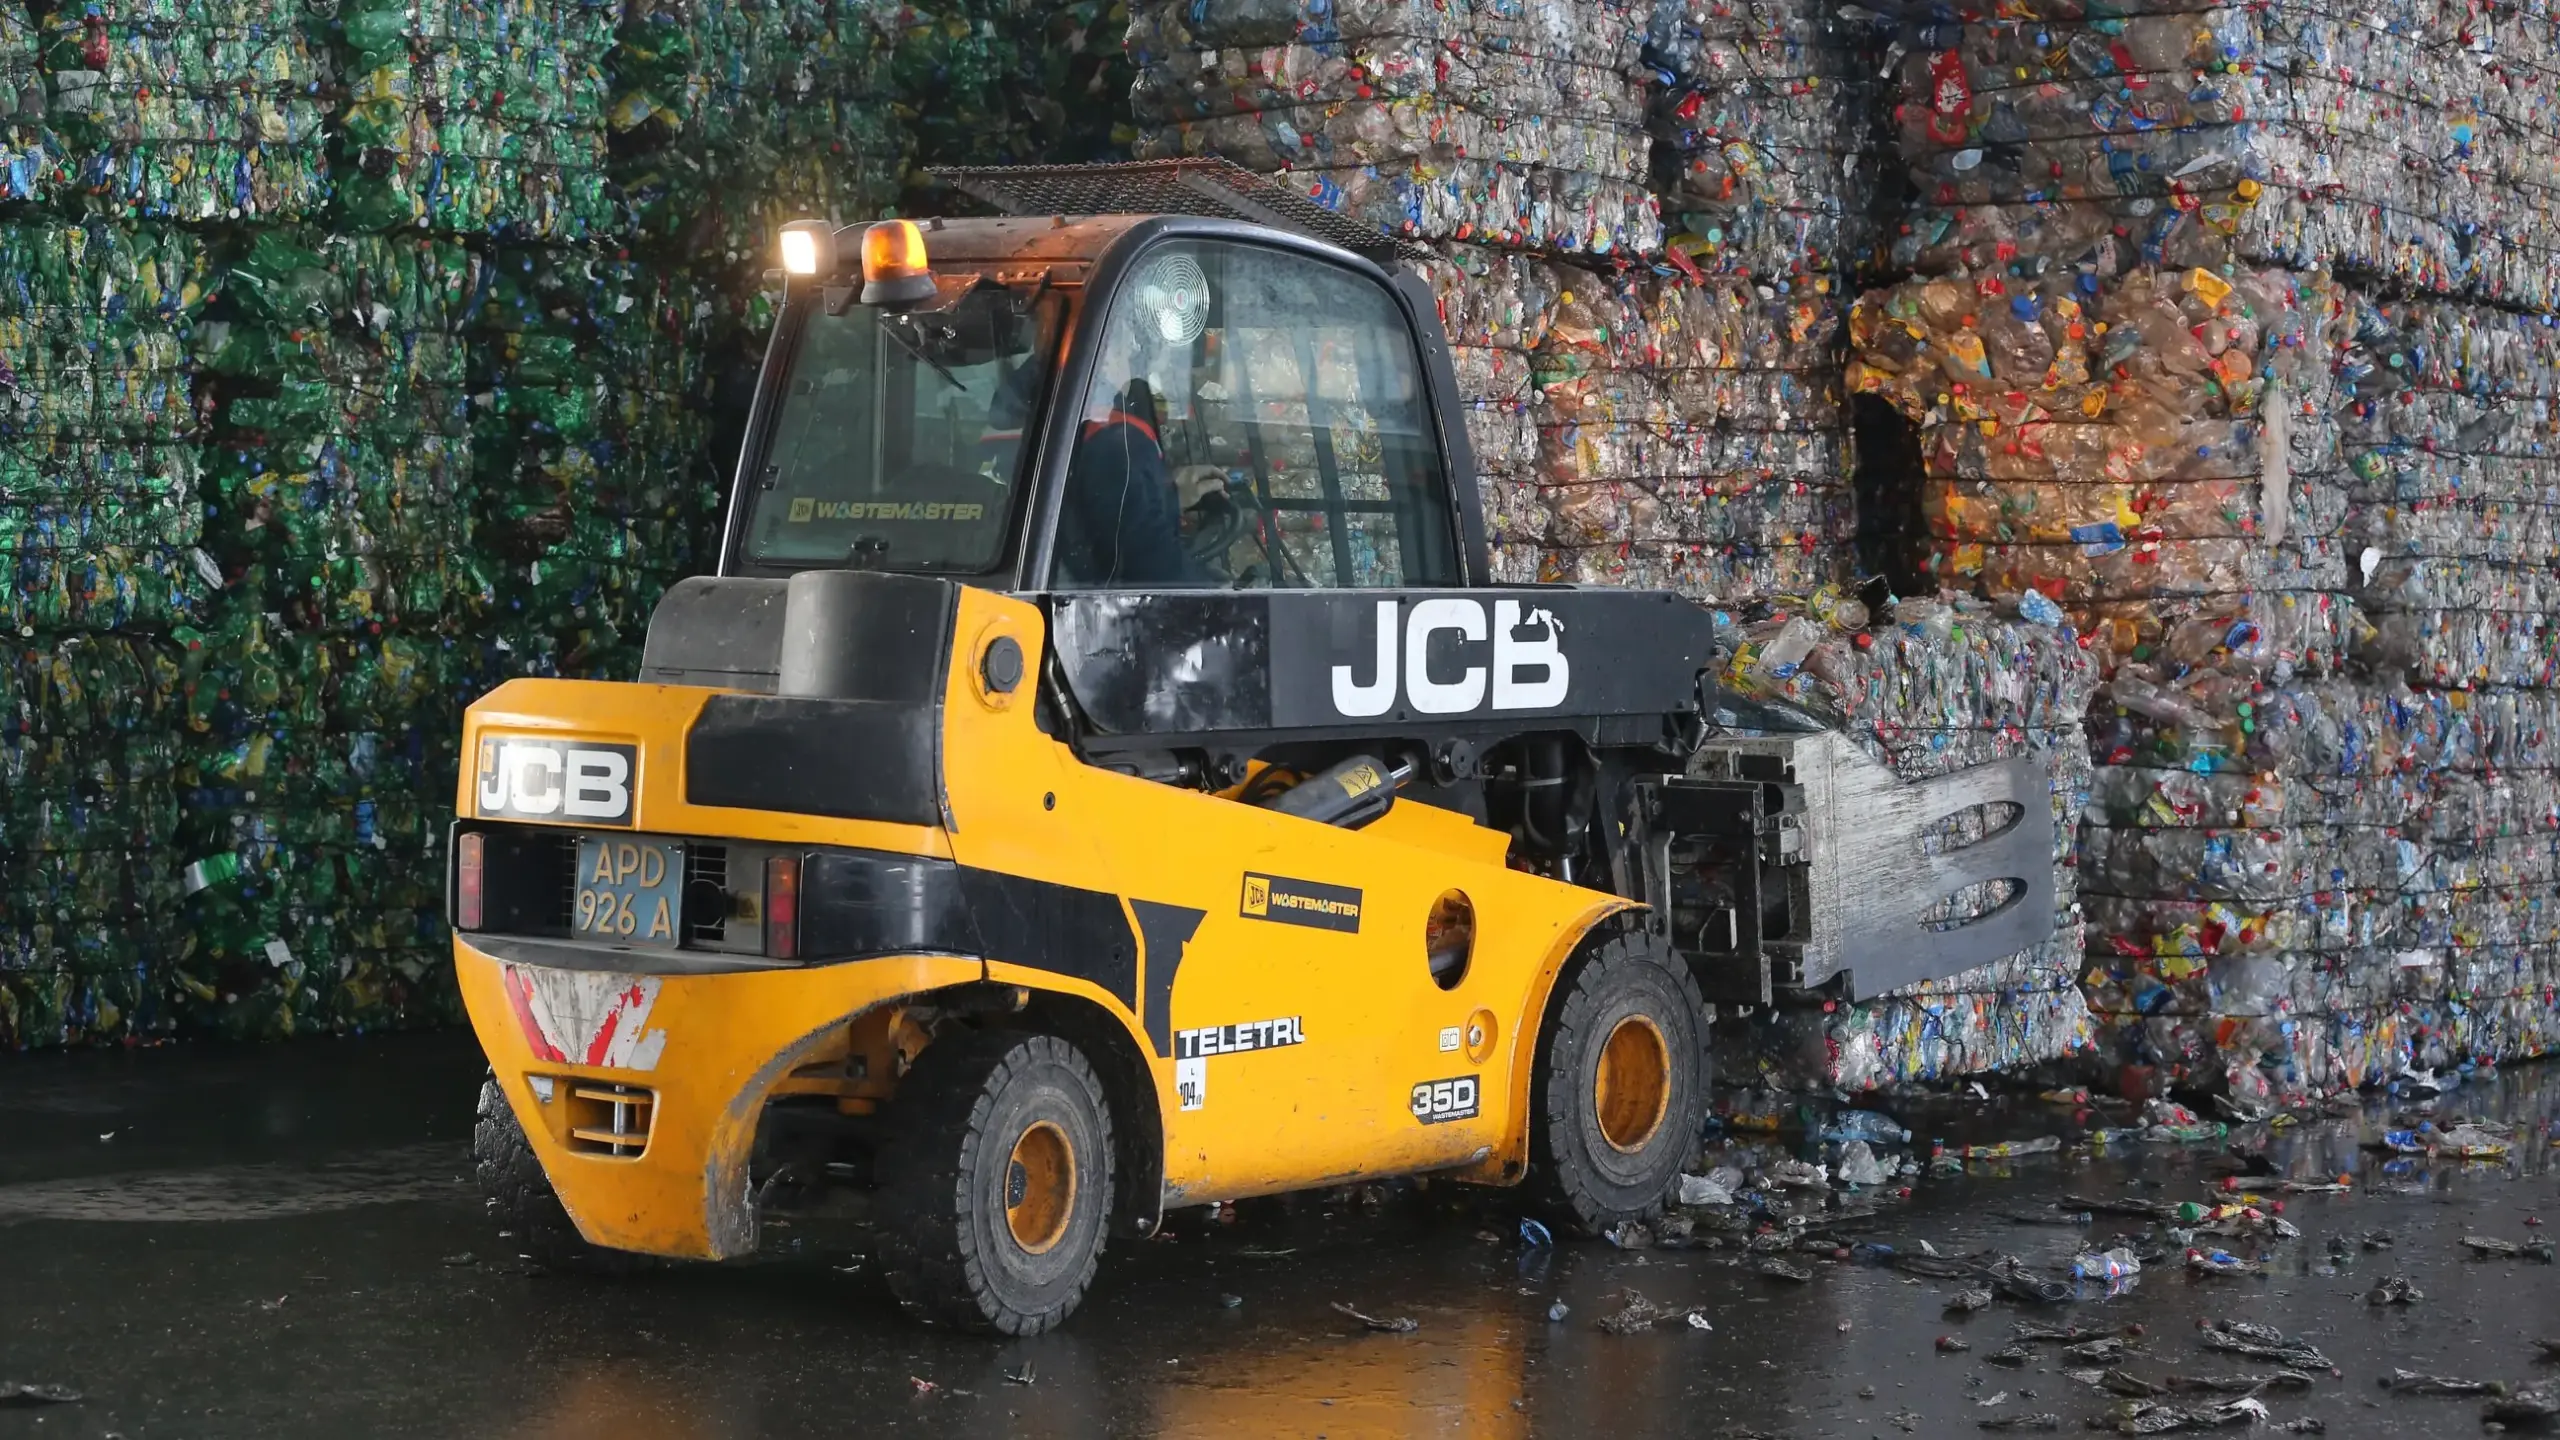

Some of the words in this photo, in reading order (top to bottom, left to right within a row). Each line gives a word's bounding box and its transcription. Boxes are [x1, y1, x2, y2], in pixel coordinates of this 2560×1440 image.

[817, 502, 984, 520] WASTEMASTER
[1331, 598, 1570, 717] JCB
[481, 743, 629, 818] JCB
[591, 842, 666, 888] APD
[578, 888, 637, 936] 926
[647, 896, 673, 940] A
[1250, 886, 1265, 906] JCB
[1271, 892, 1359, 917] WASTEMASTER
[1412, 1079, 1475, 1115] 35D
[1432, 1108, 1475, 1120] WASTEMASTER
